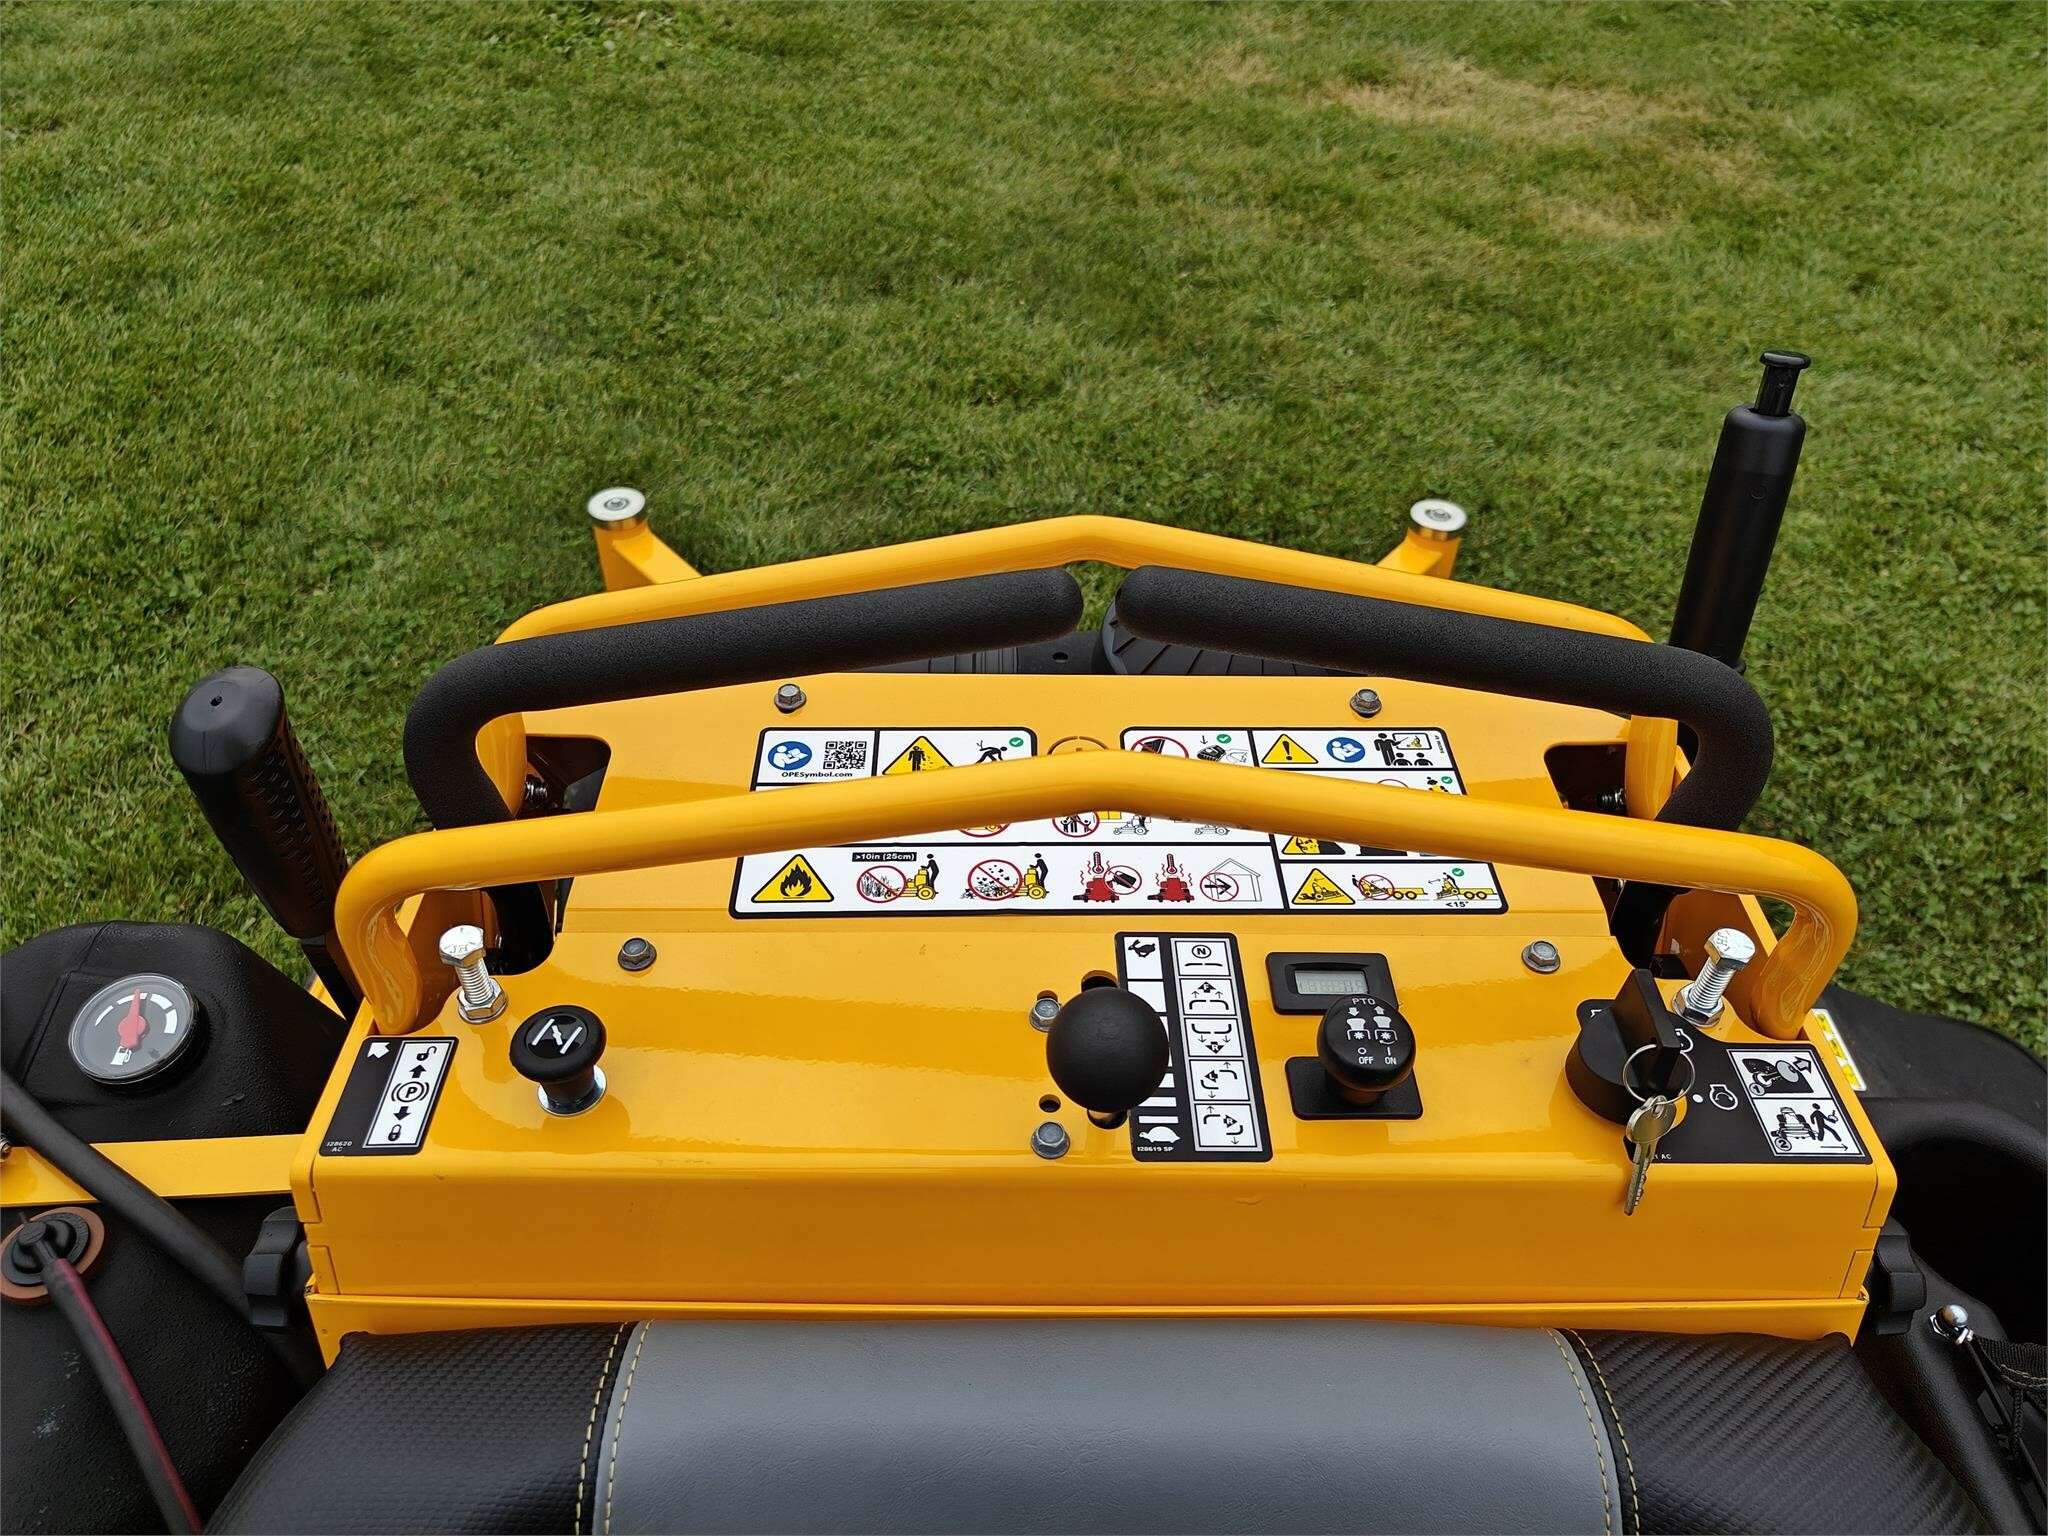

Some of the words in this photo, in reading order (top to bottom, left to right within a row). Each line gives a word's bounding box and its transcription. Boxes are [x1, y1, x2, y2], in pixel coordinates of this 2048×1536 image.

[882, 852, 915, 861] (25cm)
[1196, 947, 1207, 955] N
[1352, 997, 1376, 1005] PTO
[1211, 1043, 1220, 1052] R
[1358, 1056, 1374, 1065] OFF
[1384, 1056, 1398, 1065] ON
[405, 1086, 418, 1098] P
[1752, 1084, 1761, 1093] 1
[1778, 1139, 1790, 1149] 2
